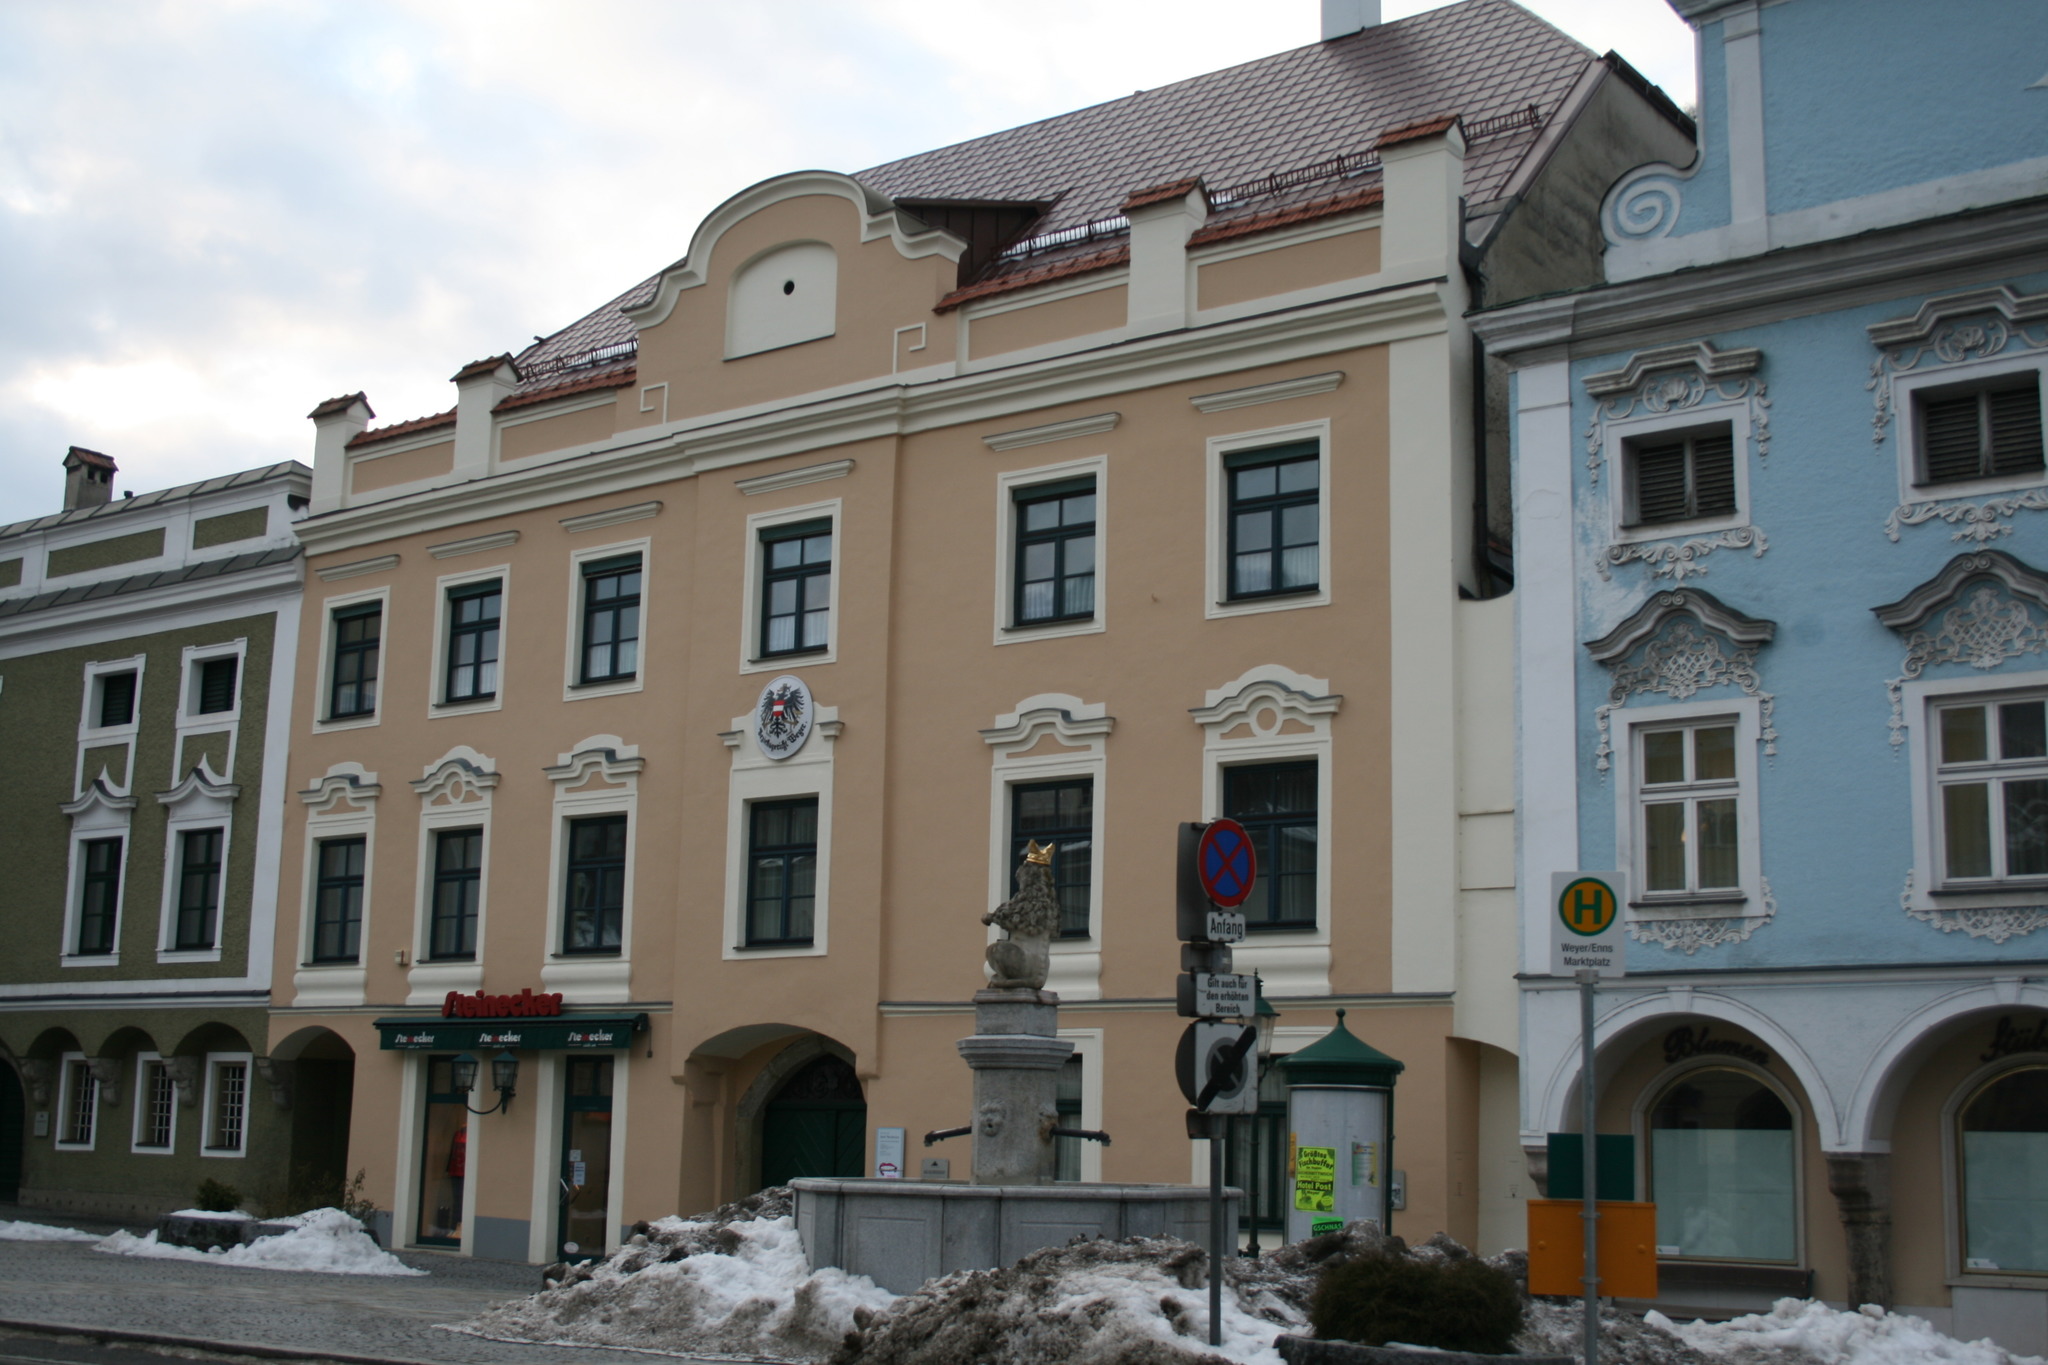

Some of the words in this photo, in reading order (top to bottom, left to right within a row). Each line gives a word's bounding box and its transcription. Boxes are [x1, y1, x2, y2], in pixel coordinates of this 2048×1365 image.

[1574, 889, 1602, 924] H
[1210, 917, 1242, 938] Anfang
[1561, 943, 1614, 954] Weyer/Enns
[1563, 957, 1611, 967] Marktplatz
[1208, 977, 1219, 987] Gilt
[1221, 979, 1237, 989] auch
[1238, 978, 1247, 988] für
[1207, 990, 1218, 999] den
[1220, 991, 1249, 1001] erhöhten
[442, 988, 564, 1018] Steinecker
[1215, 1003, 1240, 1012] Bereich
[1297, 1181, 1314, 1190] Hotel
[1315, 1182, 1332, 1191] Post
